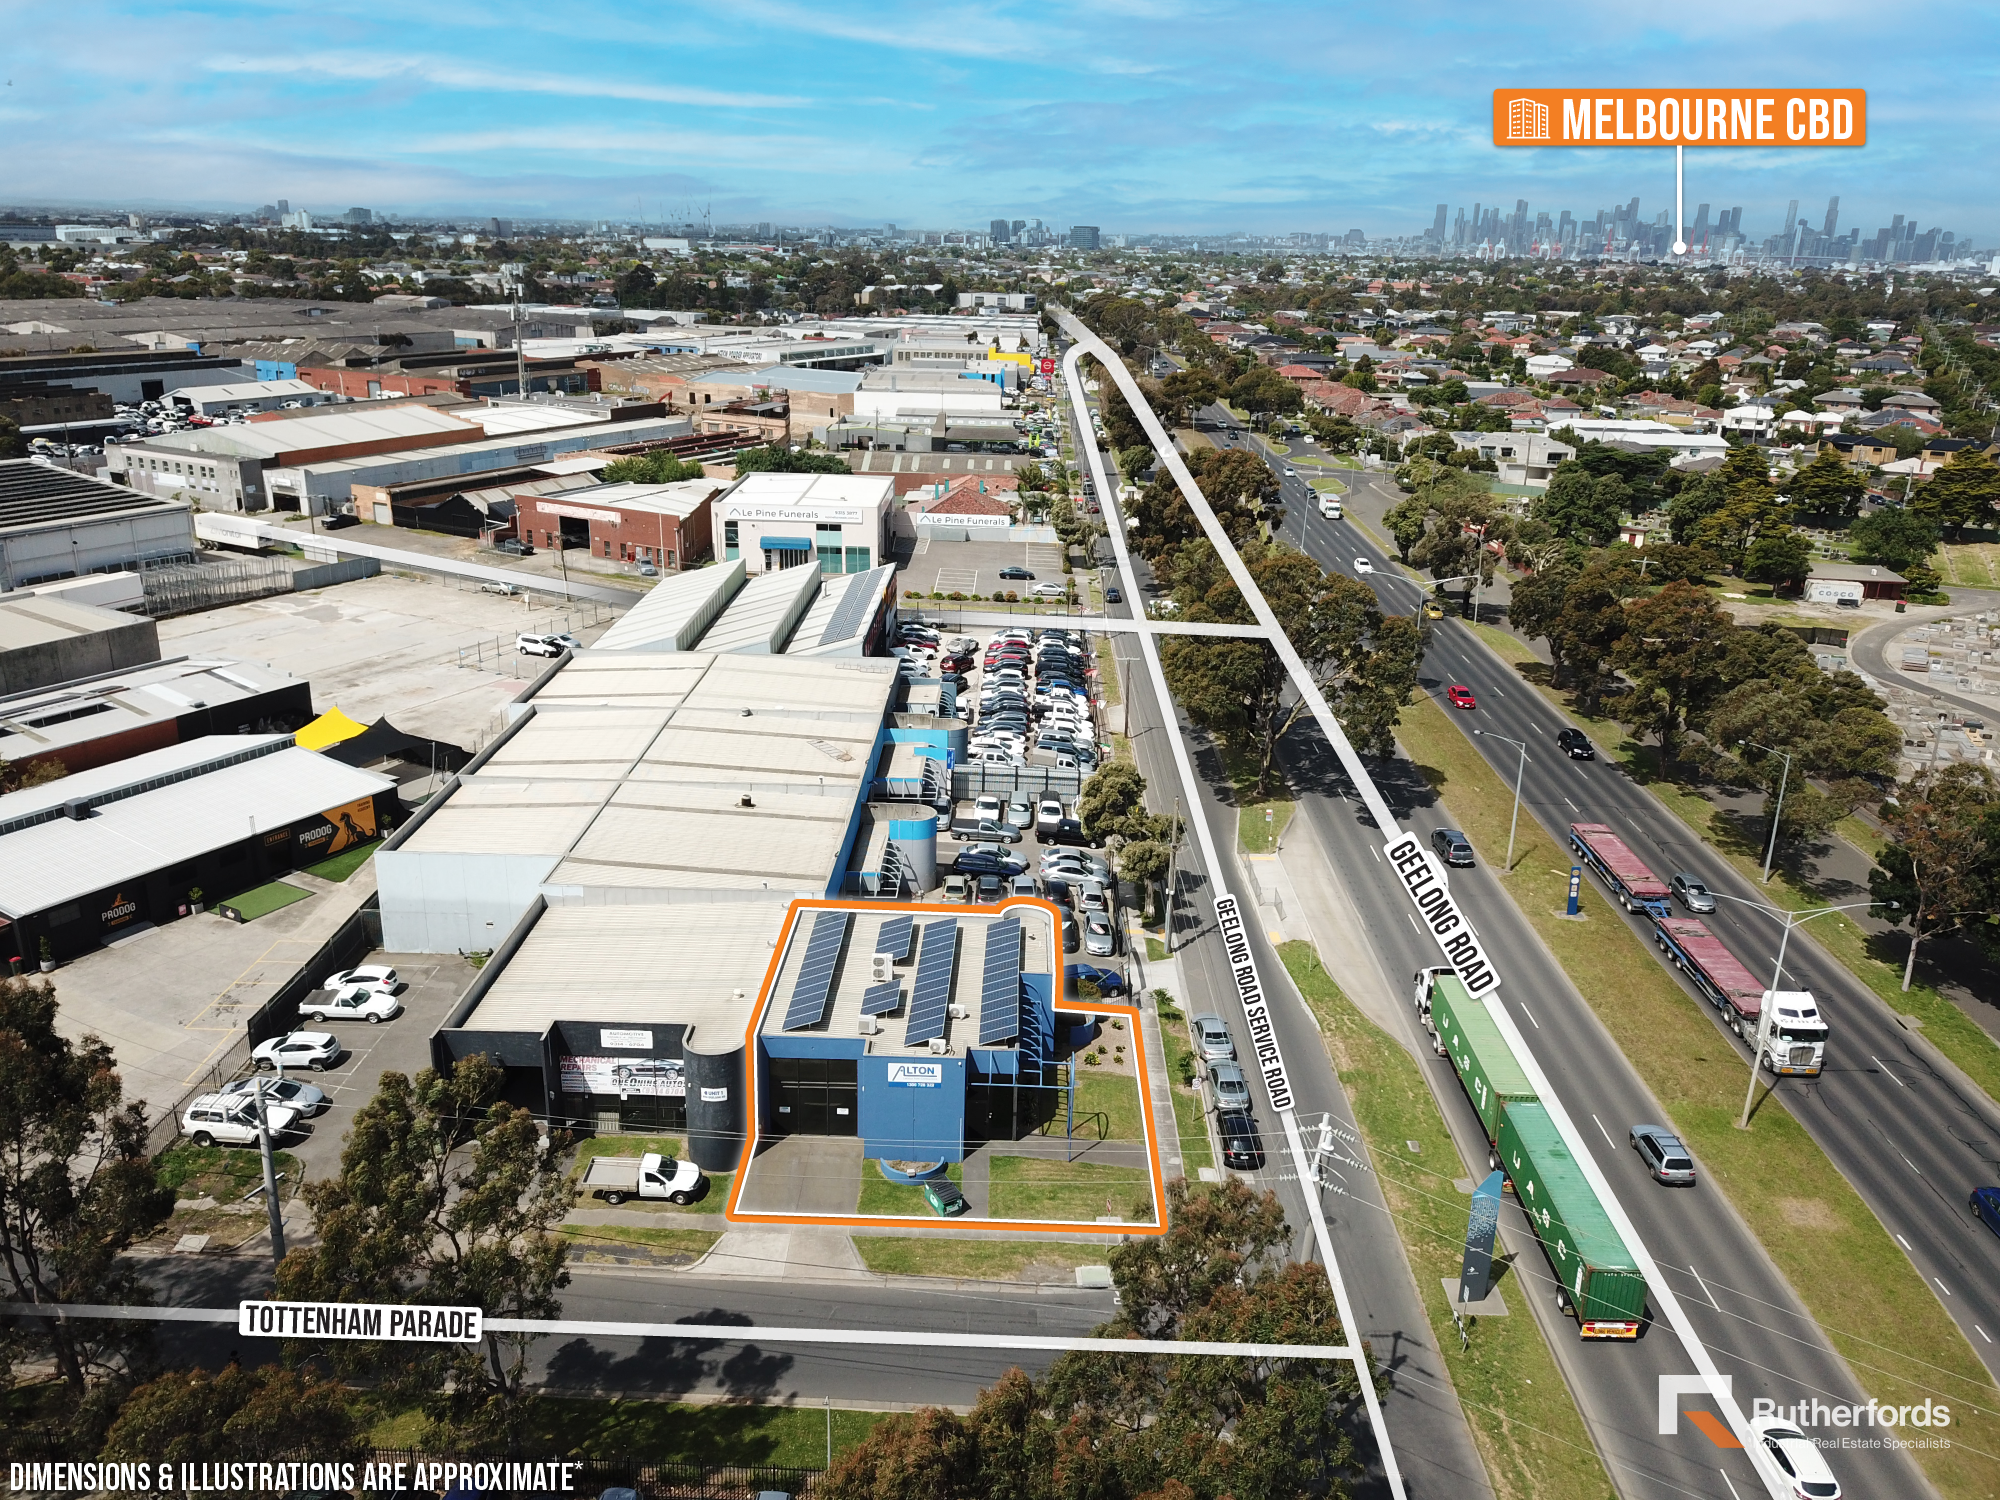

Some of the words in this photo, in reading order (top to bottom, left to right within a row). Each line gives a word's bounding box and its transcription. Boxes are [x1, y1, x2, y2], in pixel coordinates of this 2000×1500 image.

[742, 509, 753, 517] Le
[755, 509, 776, 518] Pine
[778, 510, 819, 519] Funerals
[932, 516, 942, 524] Le
[967, 517, 1005, 525] Funerals
[1818, 590, 1854, 598] COSCO
[266, 829, 289, 844] ENTRANCE
[298, 823, 333, 845] PRODOG
[101, 902, 136, 922] PRODOG
[560, 1055, 617, 1065] MECHANICAL
[560, 1063, 598, 1072] REPAIRS
[892, 1065, 936, 1081] ALTON
